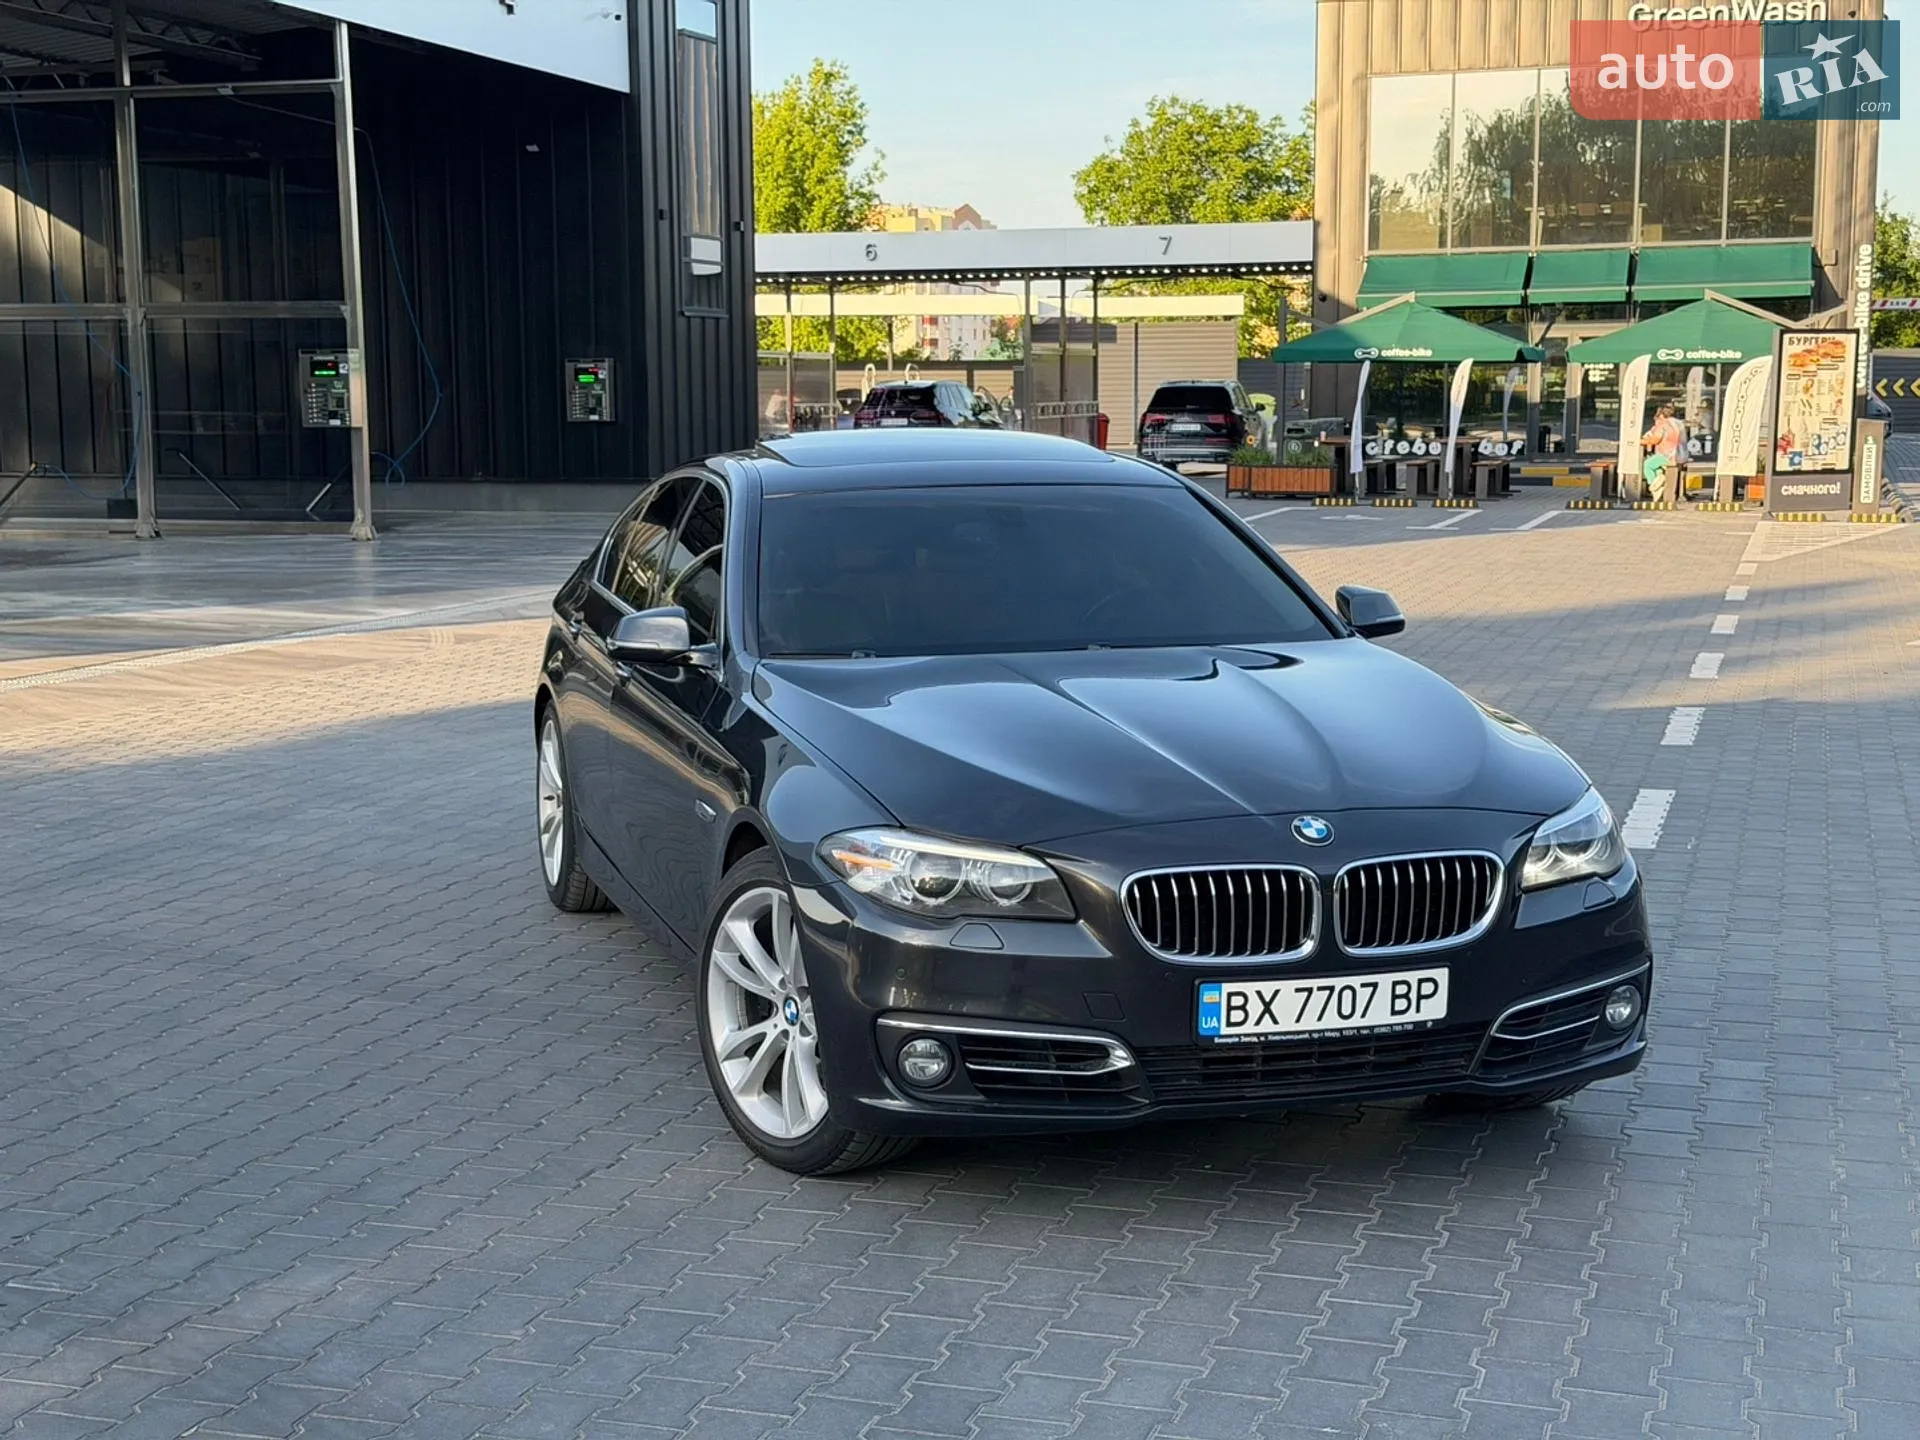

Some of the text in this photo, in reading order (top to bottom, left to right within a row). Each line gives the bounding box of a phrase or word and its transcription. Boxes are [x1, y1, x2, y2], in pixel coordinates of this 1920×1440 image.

[1628, 0, 1826, 32] GreenWash
[864, 243, 878, 262] 6
[1159, 236, 1173, 255] 7
[1856, 243, 1872, 287] drive
[1788, 336, 1836, 346] БУРГЕР
[1686, 348, 1742, 359] coffee-bike
[1202, 977, 1439, 1029] UA BX 7707 BP
